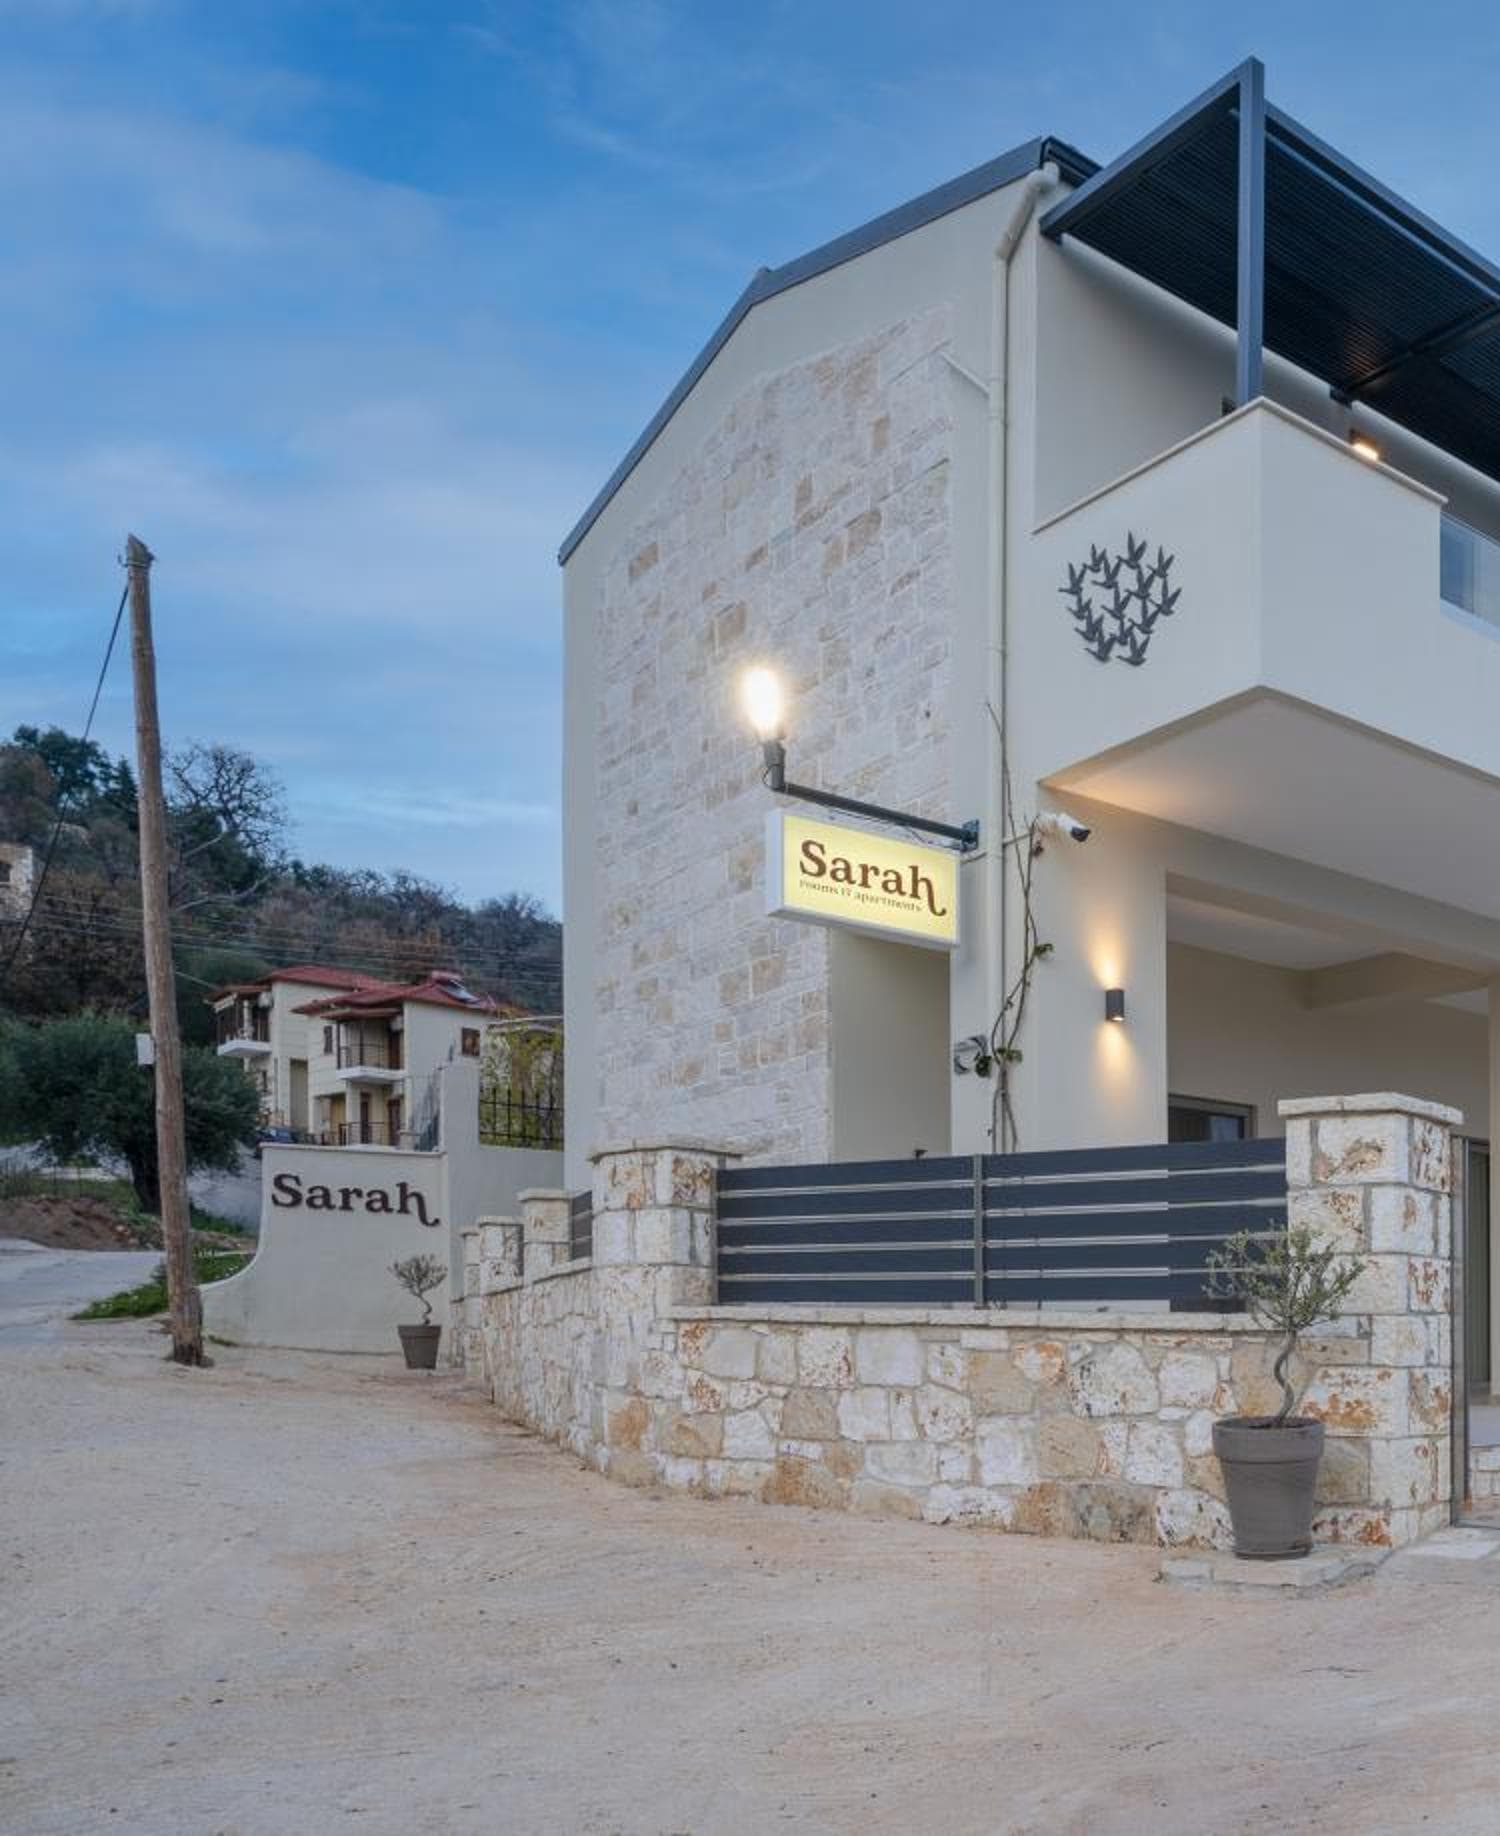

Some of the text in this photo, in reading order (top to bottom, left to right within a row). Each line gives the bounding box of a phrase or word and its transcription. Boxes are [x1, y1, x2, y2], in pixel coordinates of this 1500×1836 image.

[799, 839, 947, 917] Sarah
[799, 878, 839, 896] rooms
[854, 890, 923, 913] apartments
[271, 1173, 440, 1227] Sarah
